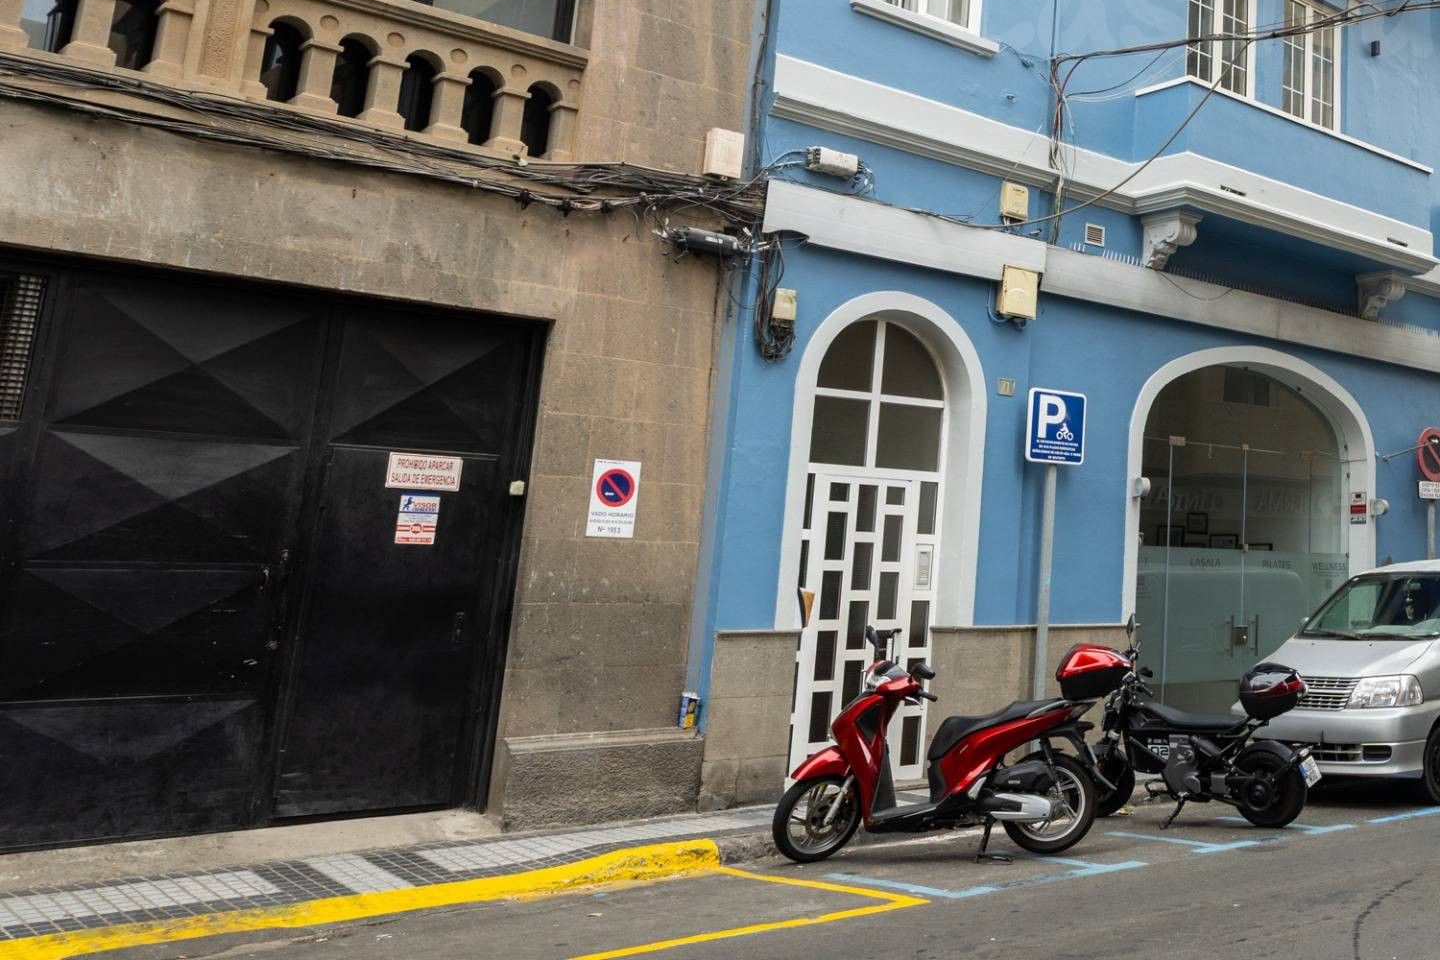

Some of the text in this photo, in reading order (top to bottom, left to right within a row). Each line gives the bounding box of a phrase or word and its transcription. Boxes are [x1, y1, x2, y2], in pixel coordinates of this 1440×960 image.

[1038, 394, 1066, 438] P
[428, 460, 454, 472] APARCAR
[391, 472, 457, 486] SALIDA DE EMERGENCIA
[413, 501, 437, 509] VISOR
[1262, 560, 1292, 570] PILATES
[1312, 560, 1346, 572] WELLNESS
